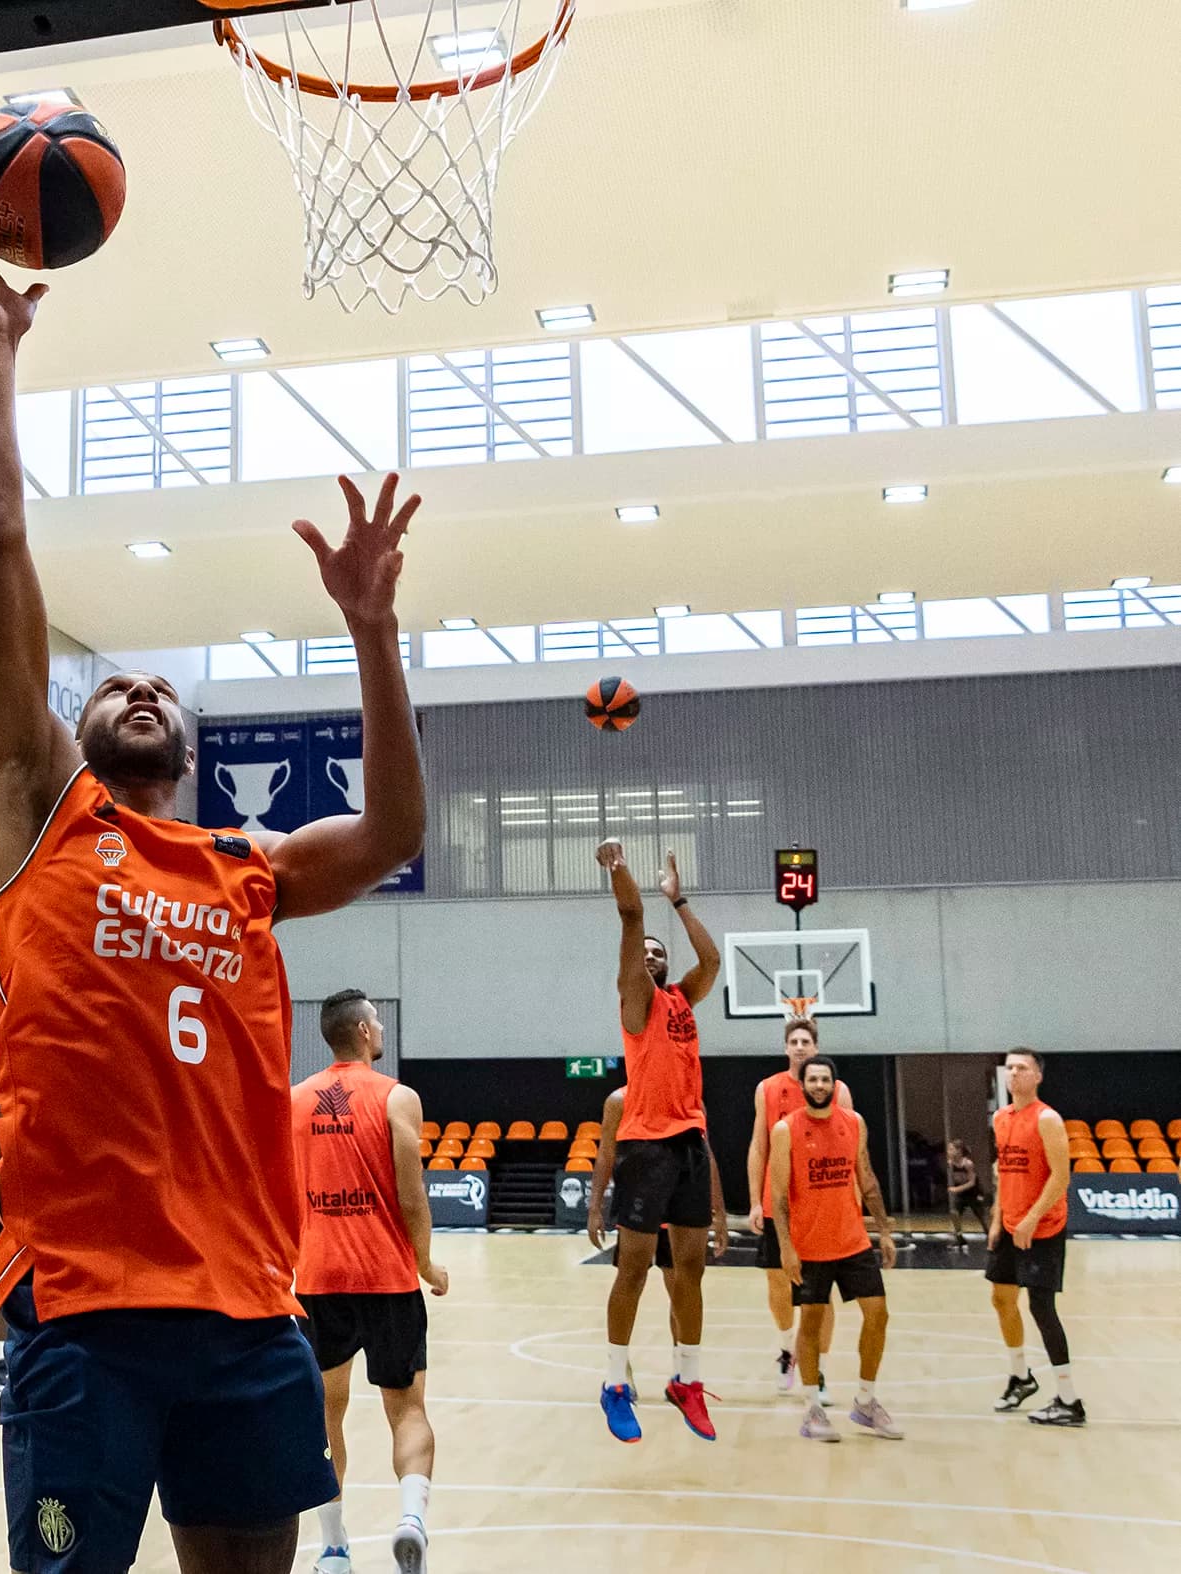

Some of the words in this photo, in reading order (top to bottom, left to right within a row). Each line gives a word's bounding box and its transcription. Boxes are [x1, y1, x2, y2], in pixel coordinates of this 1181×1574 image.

[780, 873, 814, 900] 24
[96, 883, 230, 936] Cultura
[93, 919, 243, 984] Esfuerzo
[168, 985, 207, 1065] 6
[307, 1188, 377, 1208] Vitaldin
[1077, 1187, 1179, 1209] Vitaldin
